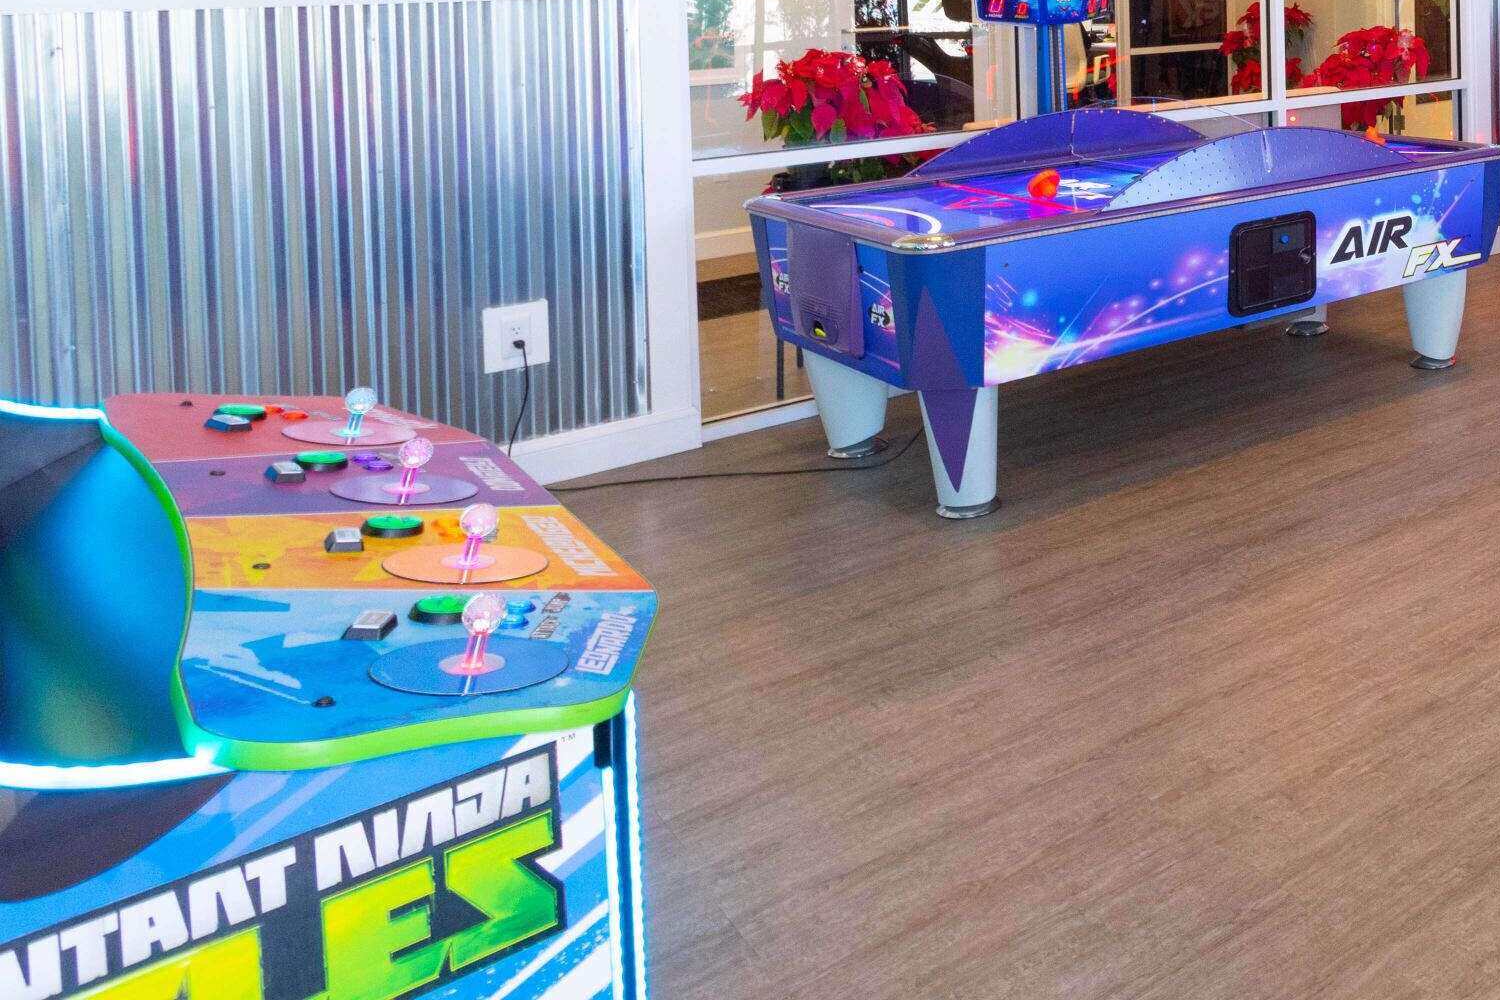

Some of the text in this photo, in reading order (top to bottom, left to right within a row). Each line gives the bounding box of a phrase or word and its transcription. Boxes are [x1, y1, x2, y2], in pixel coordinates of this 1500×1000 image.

[1331, 215, 1412, 264] AIR
[1402, 238, 1481, 278] FX
[870, 315, 886, 328] FX
[871, 303, 885, 316] AIR
[0, 846, 297, 1000] UTANT
[313, 752, 551, 892] NINJA
